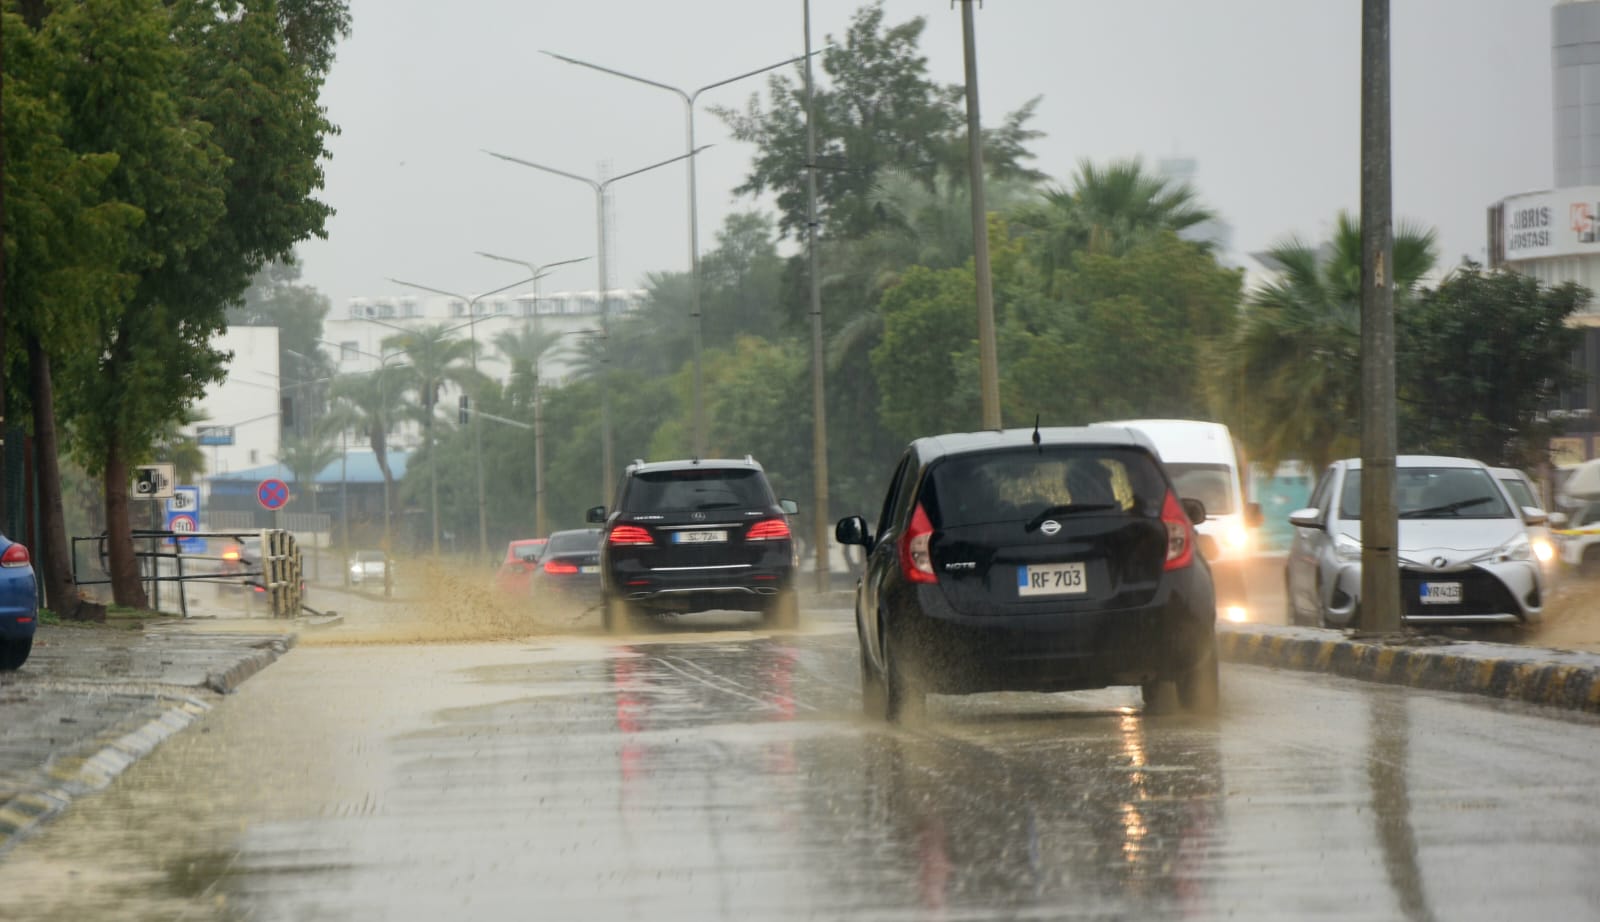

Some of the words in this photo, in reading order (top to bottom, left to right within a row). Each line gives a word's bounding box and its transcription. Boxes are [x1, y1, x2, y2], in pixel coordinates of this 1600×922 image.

[945, 561, 976, 570] NOTE
[1032, 573, 1050, 588] RF
[1054, 570, 1081, 587] 703
